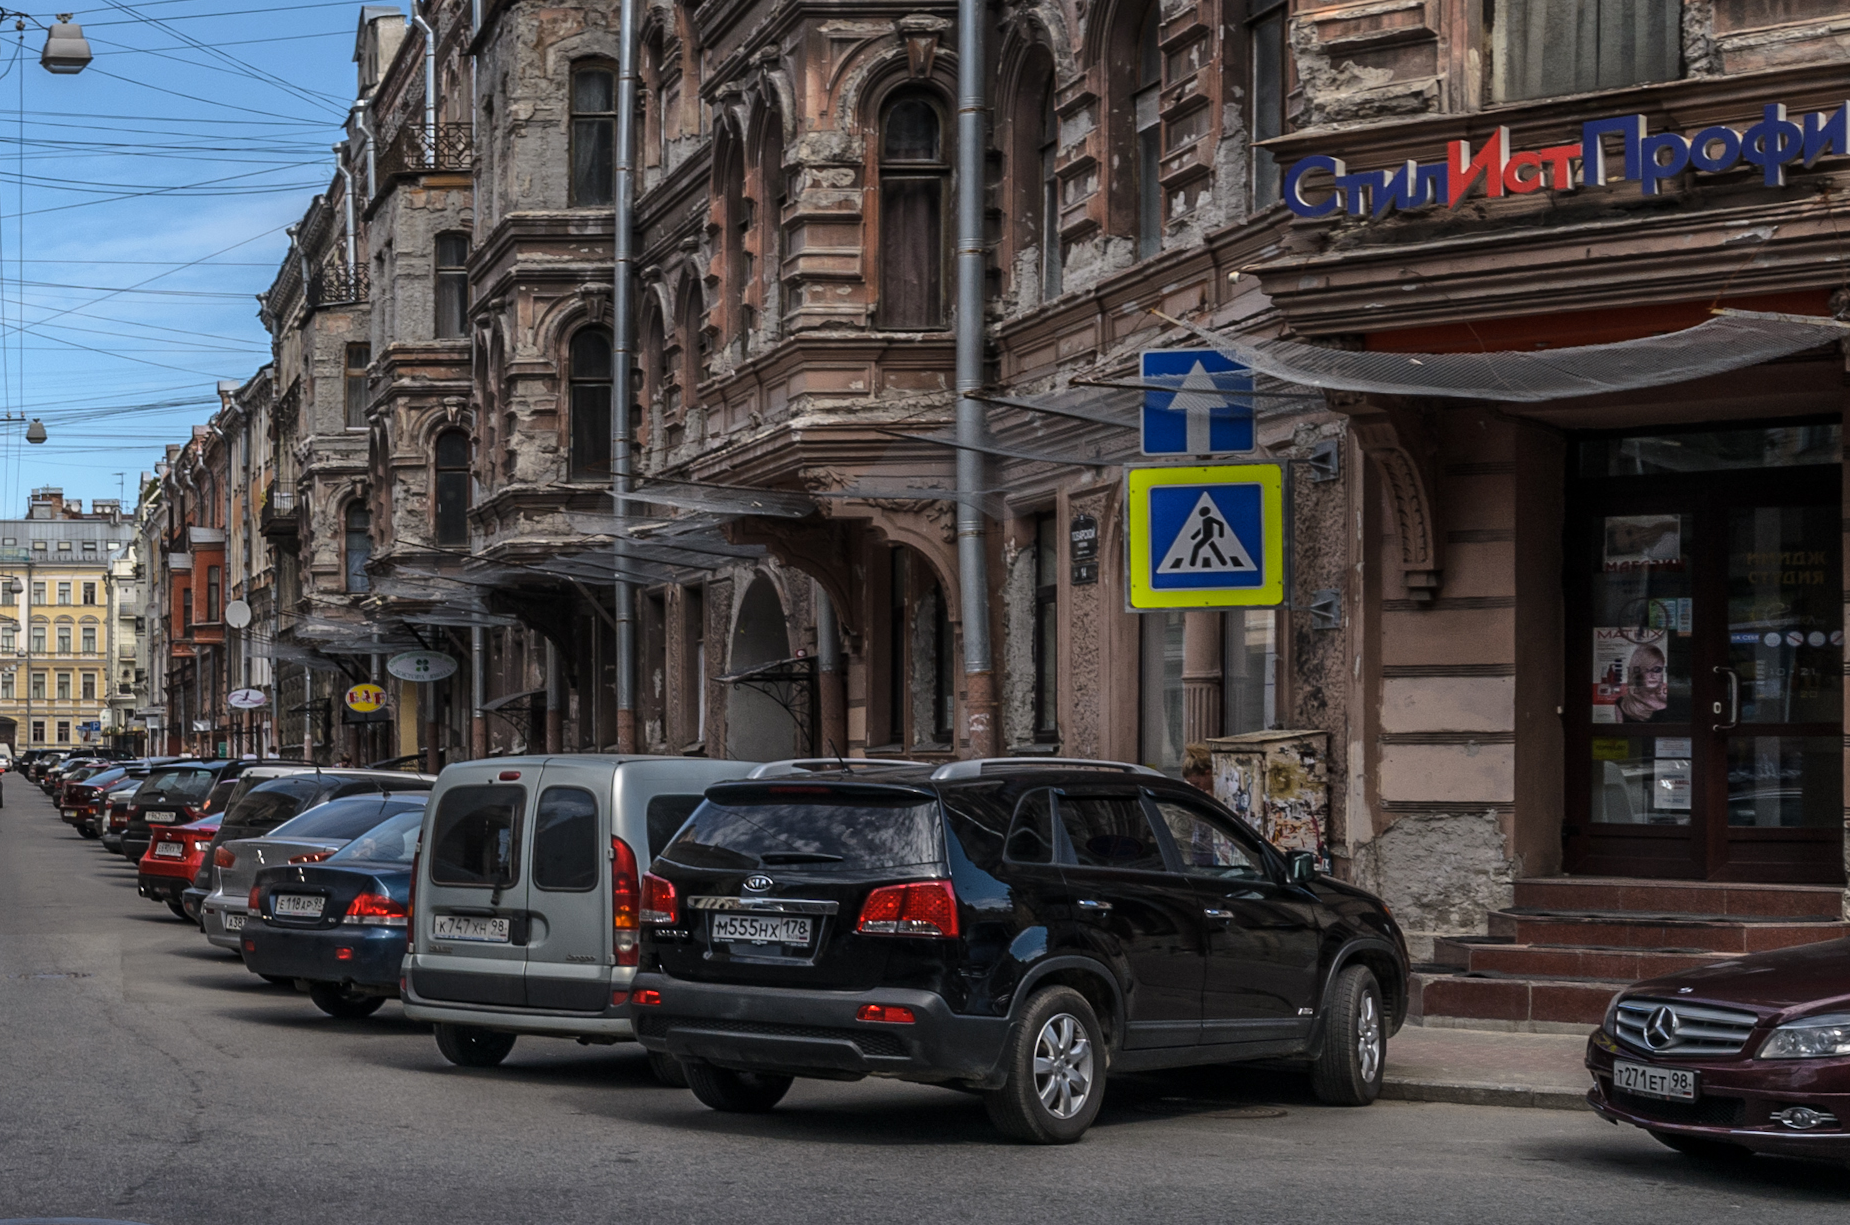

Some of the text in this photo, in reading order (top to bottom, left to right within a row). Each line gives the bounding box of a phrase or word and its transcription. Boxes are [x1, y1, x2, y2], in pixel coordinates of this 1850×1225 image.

[1597, 629, 1663, 639] MATRIX
[747, 878, 768, 889] KIA
[439, 918, 504, 935] К747ХН 98
[716, 917, 807, 938] М555НХ 178
[1618, 1067, 1688, 1091] Т271ЕТ 98
